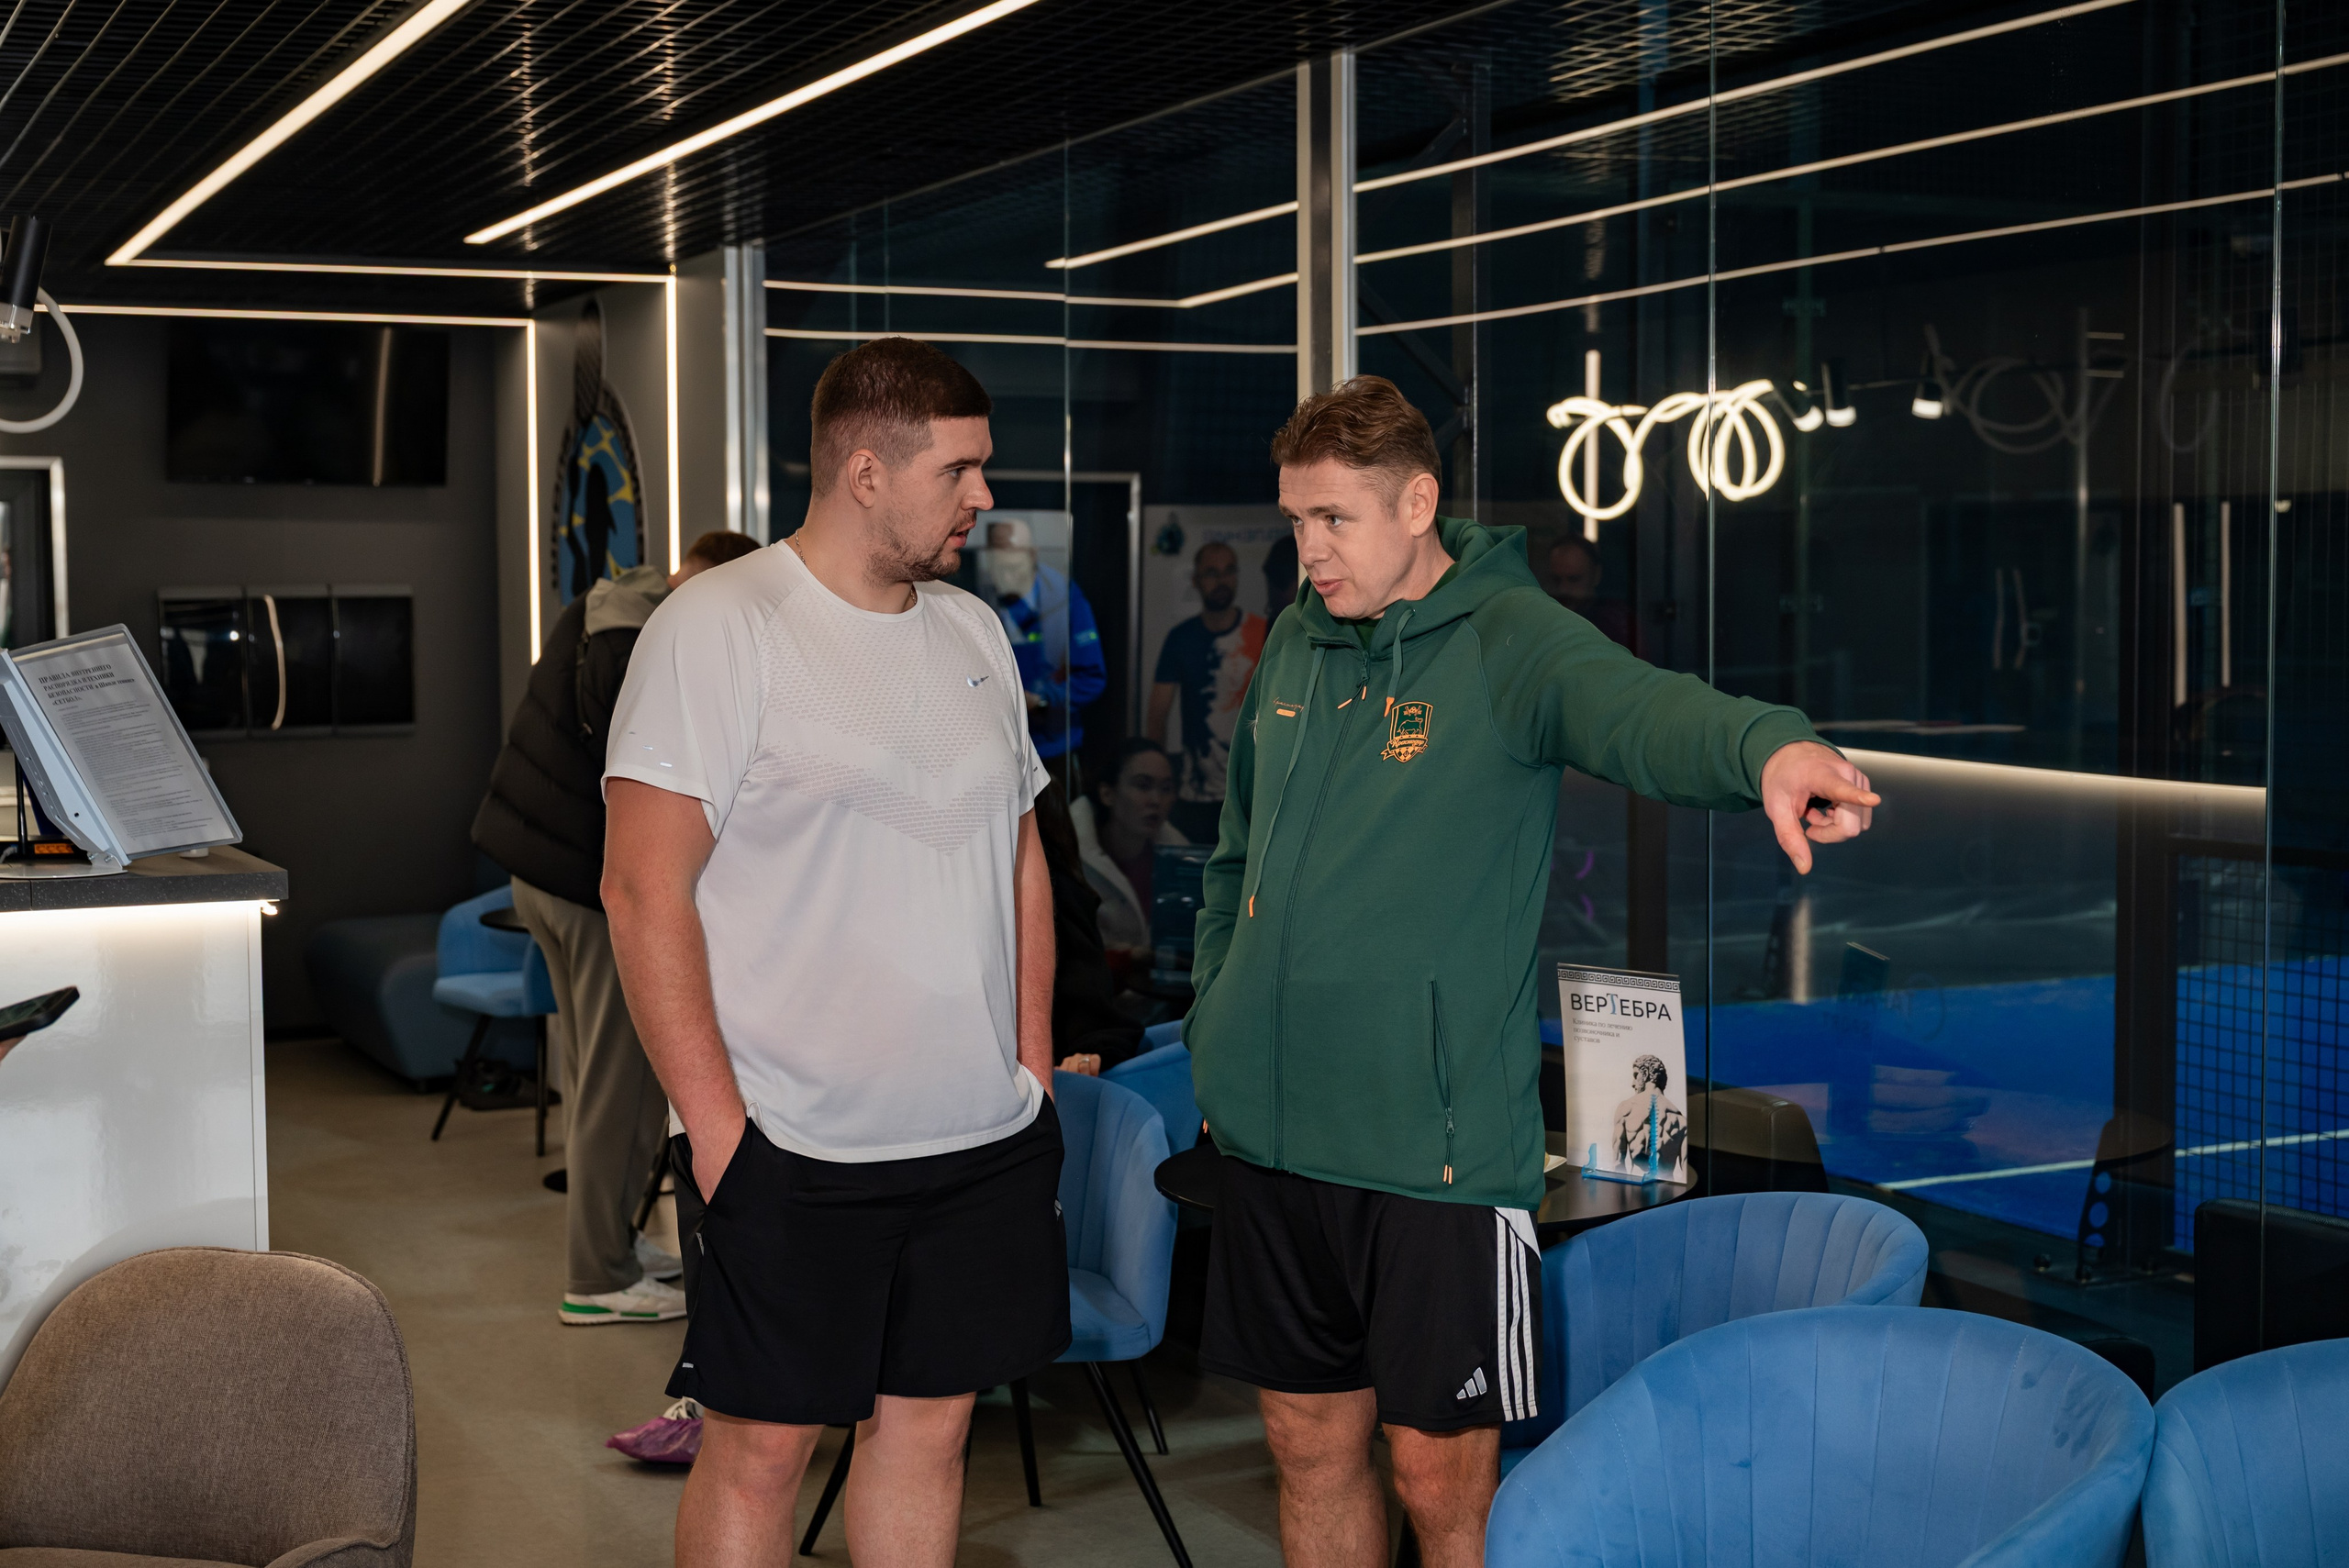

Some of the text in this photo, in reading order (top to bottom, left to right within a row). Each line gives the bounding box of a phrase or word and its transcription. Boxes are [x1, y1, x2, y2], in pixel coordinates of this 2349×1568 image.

[39, 663, 112, 684] ПРАВИЛА ВНУТРЕННЕГО
[43, 679, 83, 691] РАСПОРЯДКА
[86, 672, 115, 682] ТЕХНИКИ
[48, 684, 94, 698] БЕЗОПАСНОСТИ
[1570, 993, 1672, 1021] ВЕРТЕБРА
[1572, 1018, 1598, 1027] Клиника
[1607, 1023, 1632, 1031] лечению
[1573, 1028, 1615, 1037] позвоночника
